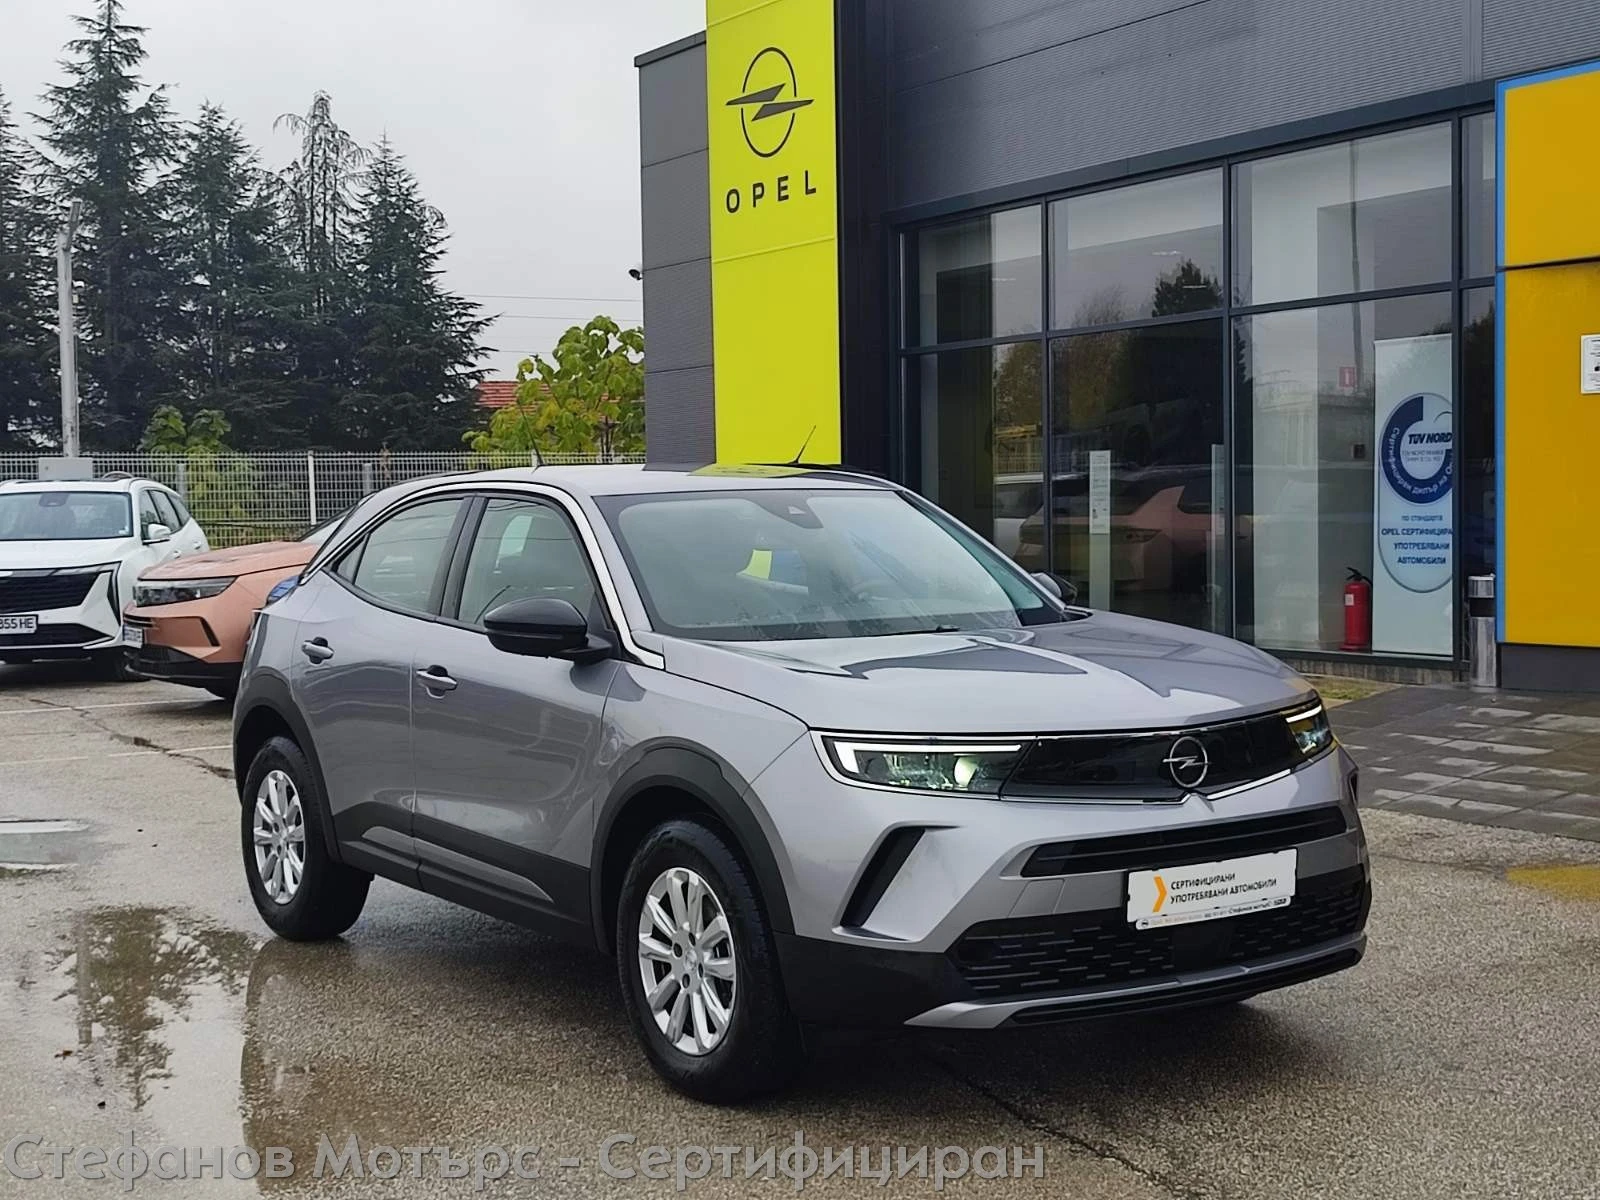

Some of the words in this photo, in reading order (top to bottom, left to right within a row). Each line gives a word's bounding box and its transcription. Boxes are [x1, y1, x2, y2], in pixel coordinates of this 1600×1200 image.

[726, 169, 817, 214] OPEL
[1425, 431, 1453, 444] NORD
[1381, 528, 1400, 536] OPEL
[1394, 542, 1450, 550] УПОТРЕБЯВАНИ
[1397, 556, 1446, 565] АВТОМОБИЛИ
[19, 617, 34, 629] HE
[1170, 873, 1236, 890] СЕРТИФИЦИРАНИ
[1170, 888, 1229, 904] УПОТРЕБЯВАНИ
[1229, 878, 1277, 895] АВТОМОБИЛИ
